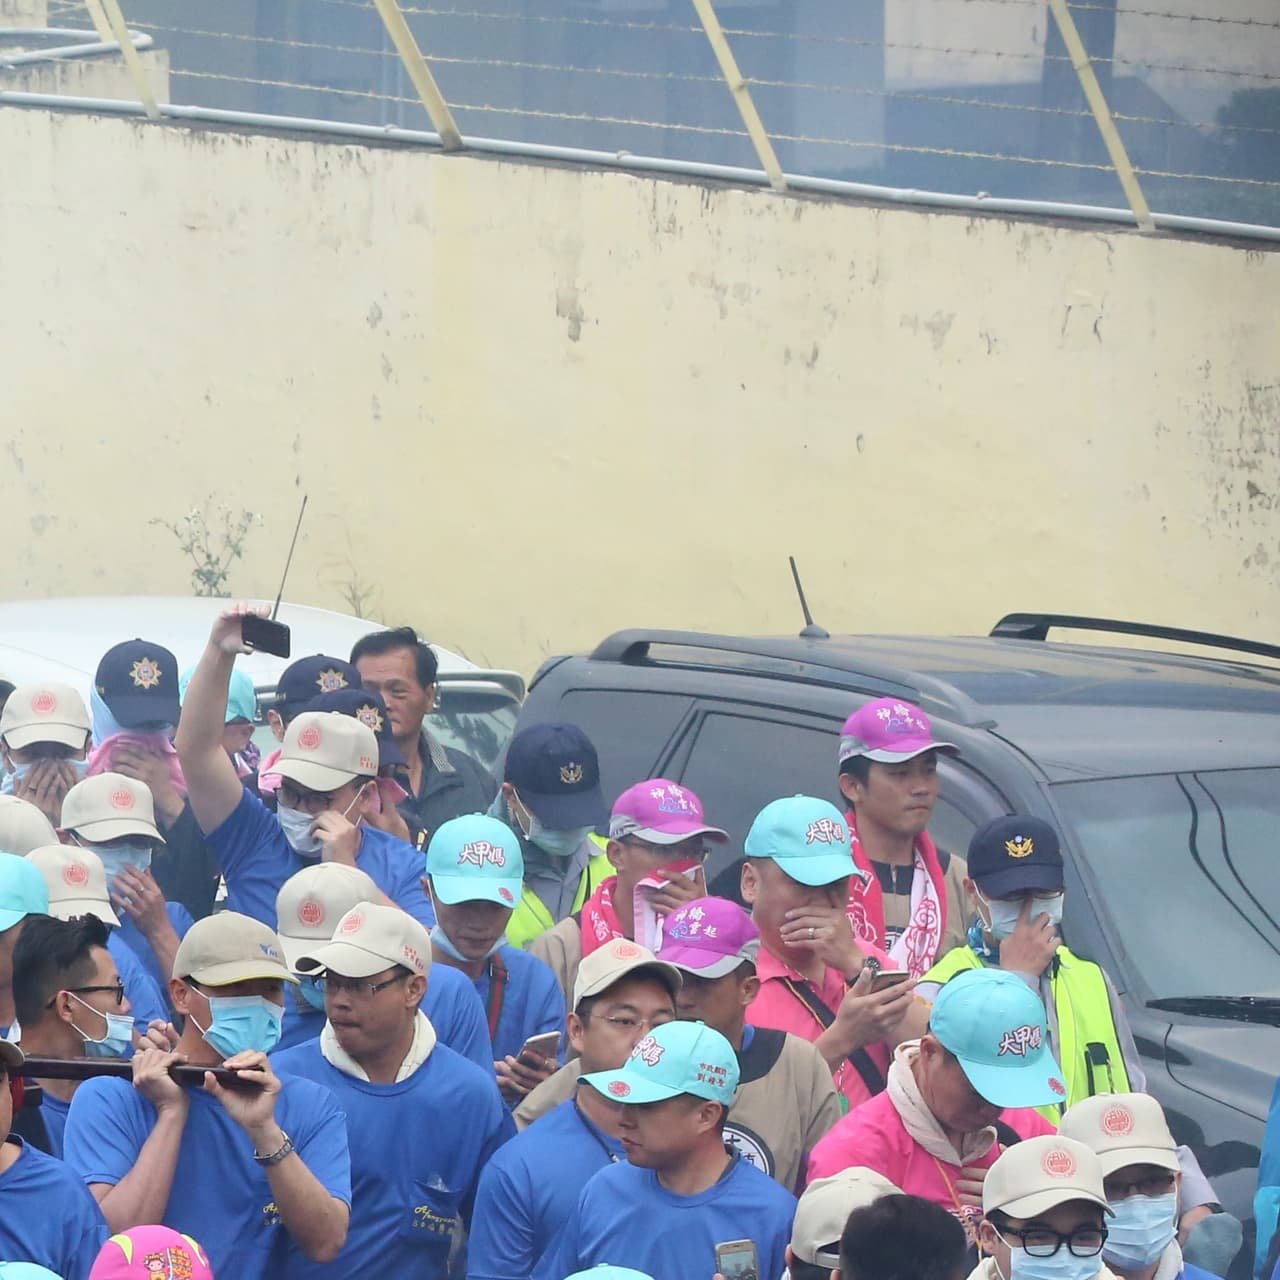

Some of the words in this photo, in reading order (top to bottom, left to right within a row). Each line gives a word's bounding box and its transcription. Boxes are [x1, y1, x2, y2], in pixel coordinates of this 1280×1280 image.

[806, 818, 846, 846] 大甲媽
[457, 841, 507, 869] 大甲媽
[996, 1024, 1044, 1059] 大甲媽
